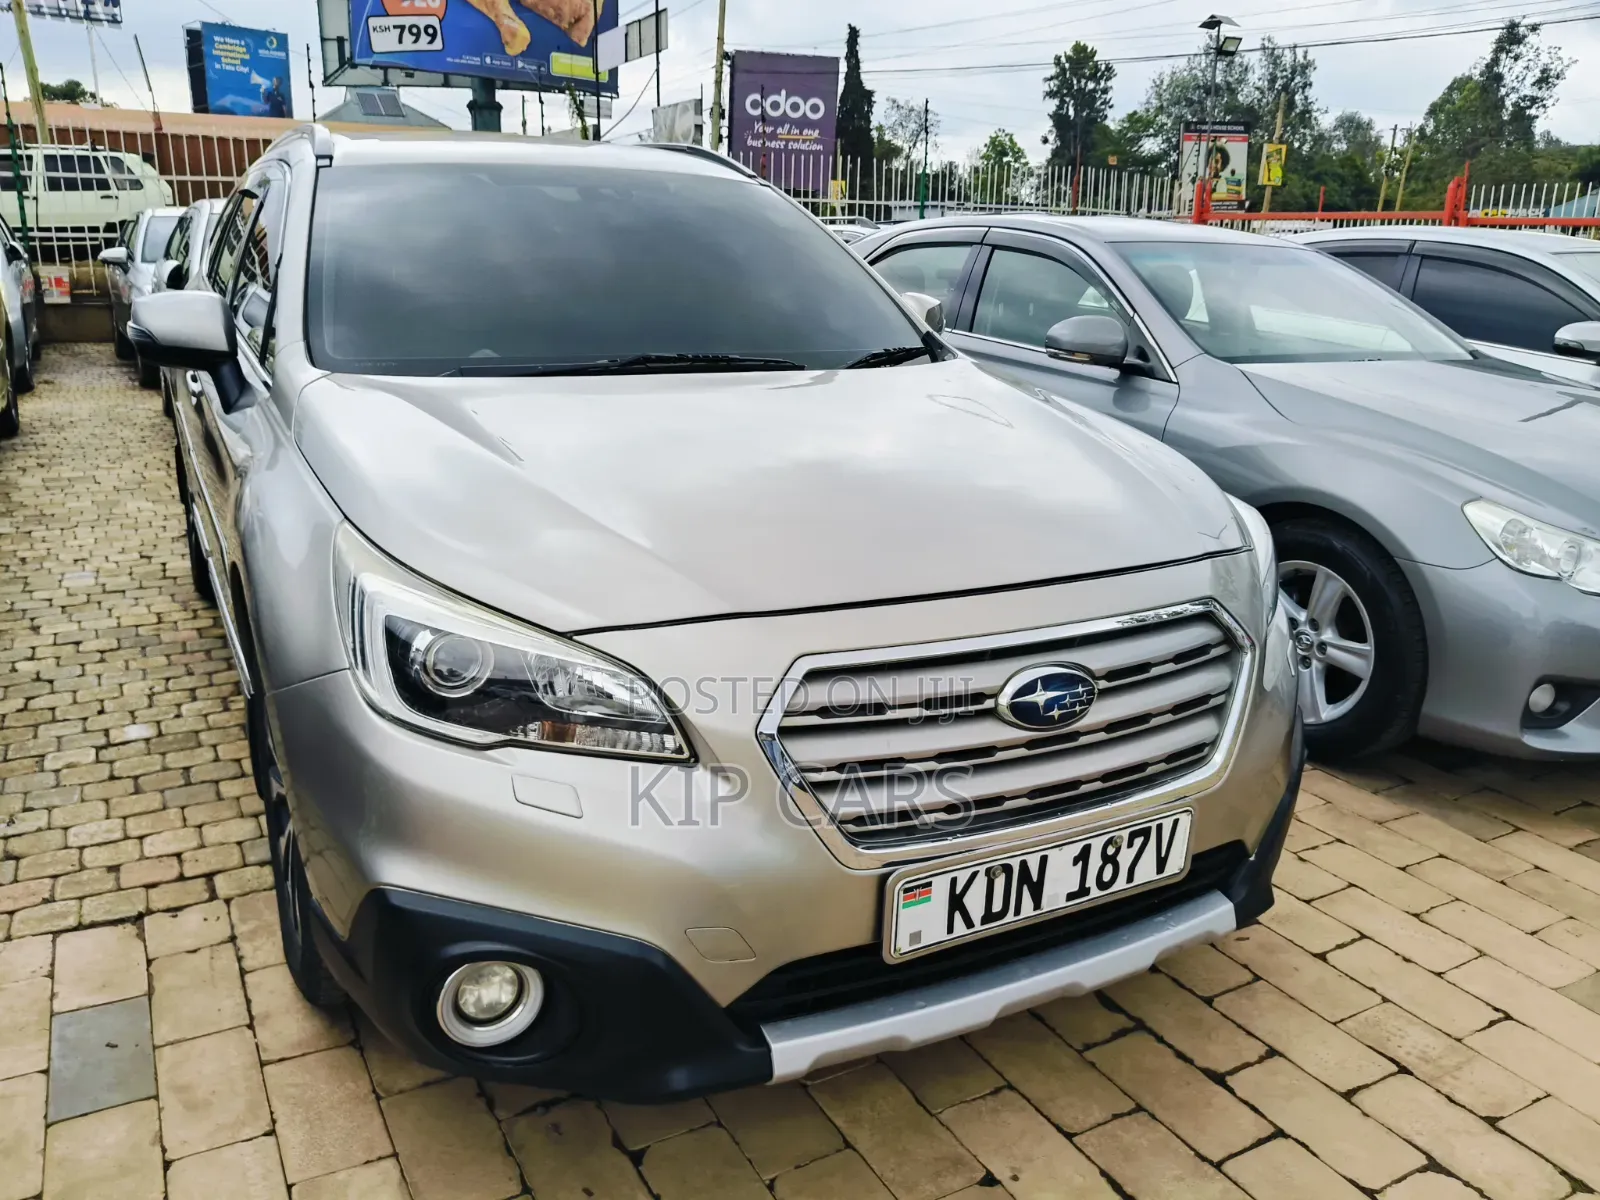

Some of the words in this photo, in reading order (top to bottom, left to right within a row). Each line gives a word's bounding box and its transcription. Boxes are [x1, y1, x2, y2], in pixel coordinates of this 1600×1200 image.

[372, 25, 391, 33] KSH
[392, 24, 438, 45] 799
[745, 88, 825, 120] odoo
[776, 122, 790, 135] all
[791, 125, 800, 136] in
[802, 127, 820, 137] one
[746, 136, 786, 150] busness
[787, 138, 824, 152] solution
[946, 854, 1049, 935] KDN
[1065, 817, 1180, 903] 187V
